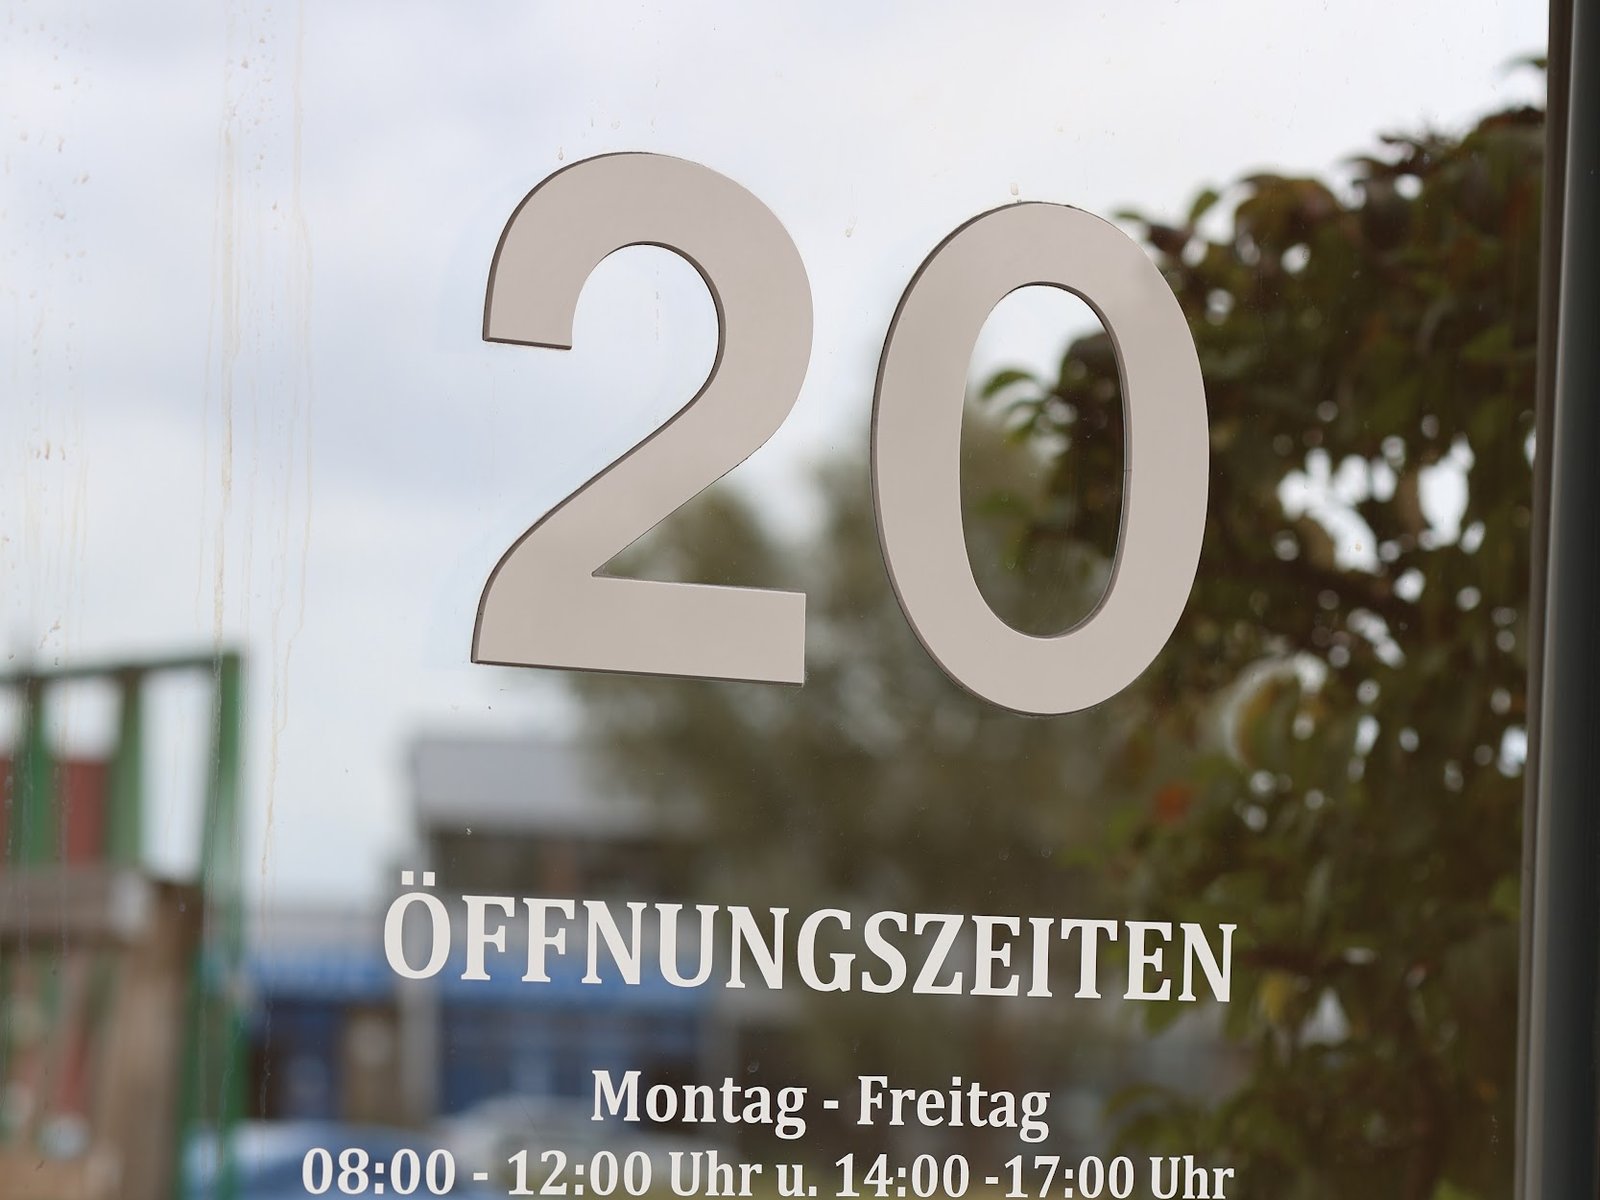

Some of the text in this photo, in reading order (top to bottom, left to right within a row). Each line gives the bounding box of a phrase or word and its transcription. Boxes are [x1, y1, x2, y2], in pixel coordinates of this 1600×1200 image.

[471, 152, 1211, 716] 20
[384, 871, 1237, 1003] ÖFFNUNGSZEITEN
[591, 1070, 1050, 1143] Montag - Freitag
[302, 1148, 455, 1195] 08:00
[473, 1172, 489, 1181] -
[508, 1150, 651, 1196] 12:00
[669, 1150, 762, 1196] Uhr
[776, 1164, 817, 1196] u.
[836, 1153, 969, 1197] 14:00
[1149, 1155, 1234, 1199] Uhr
